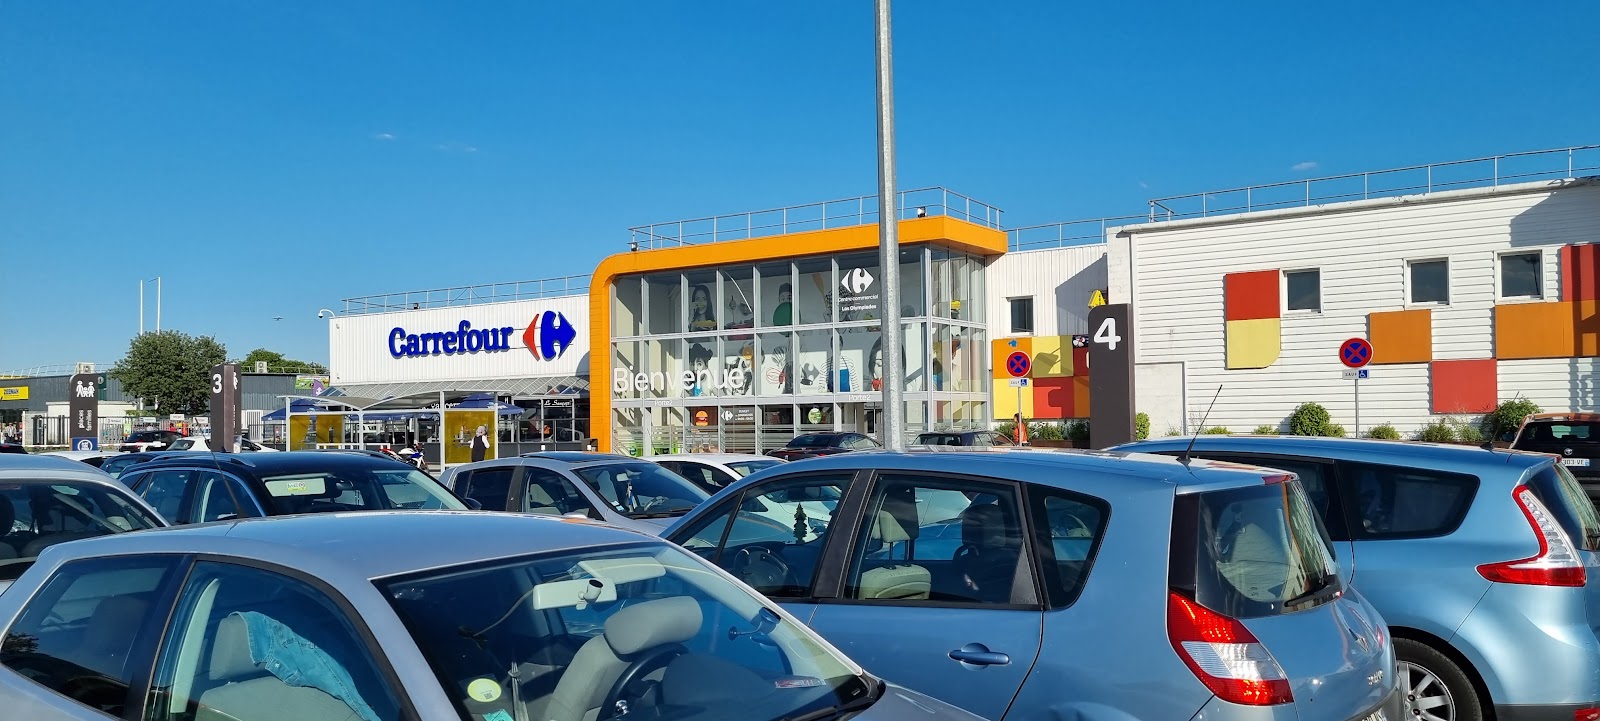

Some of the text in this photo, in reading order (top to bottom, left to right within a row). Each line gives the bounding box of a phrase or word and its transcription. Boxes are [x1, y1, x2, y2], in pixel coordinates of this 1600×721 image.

[389, 320, 513, 358] Carrefour
[1093, 317, 1122, 350] 4
[212, 373, 223, 394] 3
[613, 365, 744, 391] Bienvenue
